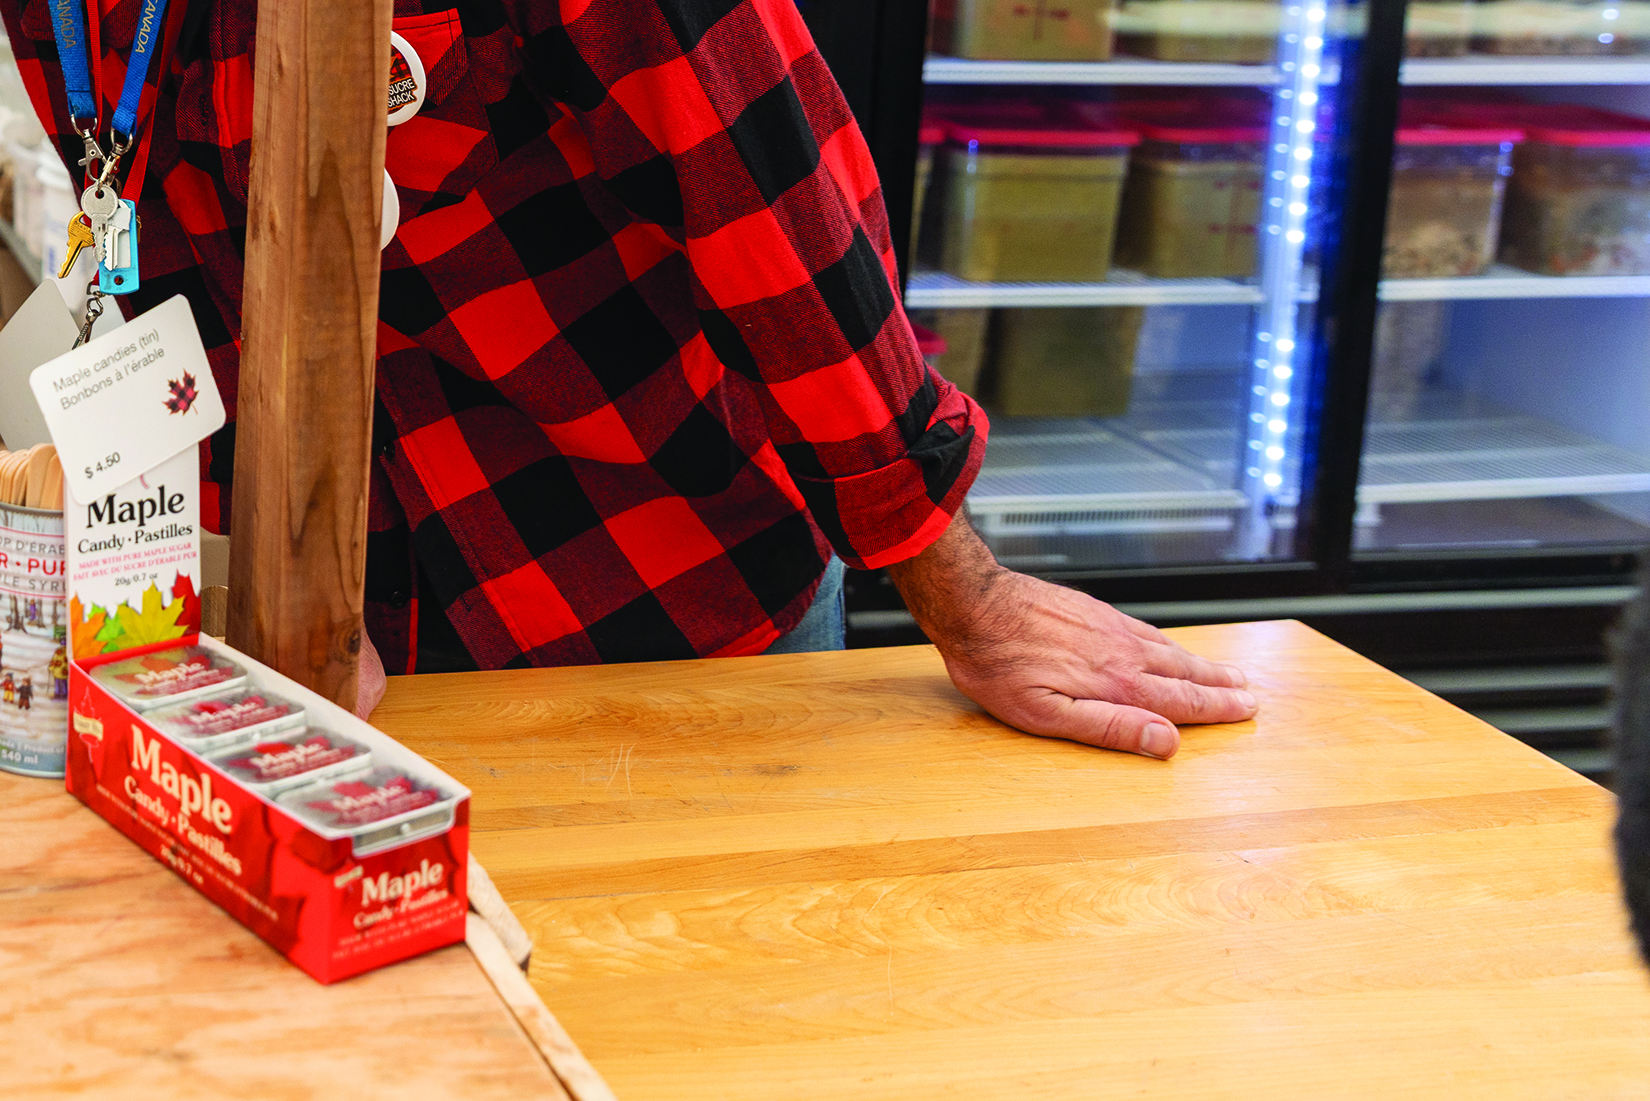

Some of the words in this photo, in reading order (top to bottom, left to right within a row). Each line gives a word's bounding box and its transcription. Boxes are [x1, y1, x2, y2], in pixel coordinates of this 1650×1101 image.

[389, 79, 416, 96] SUCRE
[53, 368, 91, 392] Maple
[93, 343, 137, 372] candies
[138, 328, 159, 350] (tin)
[60, 375, 113, 410] Bonbons
[115, 368, 124, 382] à
[84, 466, 94, 479] $
[95, 451, 122, 473] 4.50
[86, 484, 185, 529] Maple
[78, 534, 125, 554] Candy
[134, 523, 193, 544] Pastilles
[73, 571, 89, 580] FAIT
[91, 567, 110, 577] AVEC
[111, 564, 121, 573] DU
[124, 560, 147, 571] SUCRE
[183, 550, 197, 559] PUR
[79, 560, 100, 569] MADE
[101, 556, 122, 564] WITH
[123, 552, 142, 560] PURE
[144, 546, 168, 557] MAPLE
[169, 542, 192, 552] SUGAR
[134, 662, 205, 684] Maple
[1, 749, 22, 762] 540
[24, 754, 38, 764] ml
[131, 723, 233, 835] Maple
[124, 775, 170, 826] Candy
[177, 811, 242, 876] Pastilles
[361, 858, 444, 908] Maple
